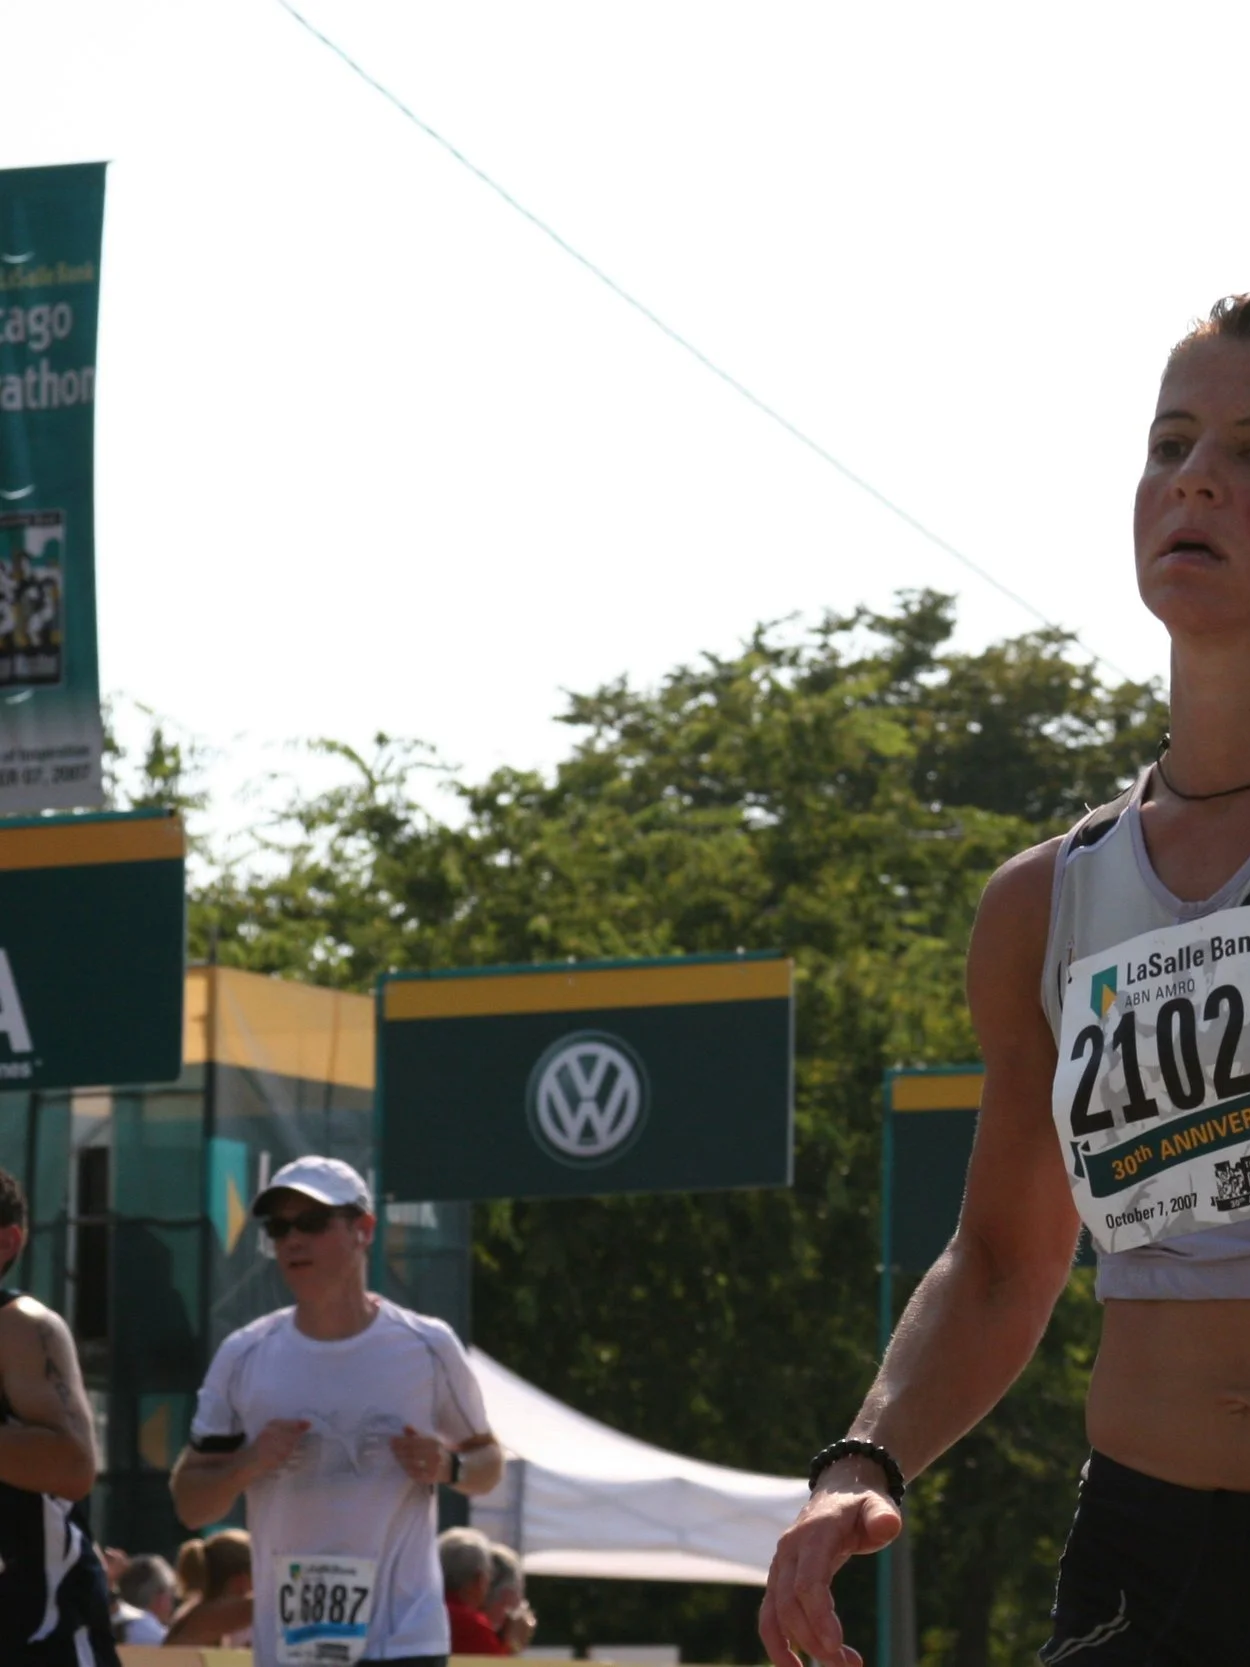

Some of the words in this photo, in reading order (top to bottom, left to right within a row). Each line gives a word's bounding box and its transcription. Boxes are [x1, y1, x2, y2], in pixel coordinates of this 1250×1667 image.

[1126, 942, 1204, 986] LaSalle
[1125, 989, 1151, 1008] ABN
[1156, 978, 1196, 1000] AMRO
[1111, 1144, 1154, 1181] 30th
[1106, 1205, 1155, 1229] October
[1158, 1201, 1169, 1218] 7,
[1170, 1193, 1198, 1215] 2007
